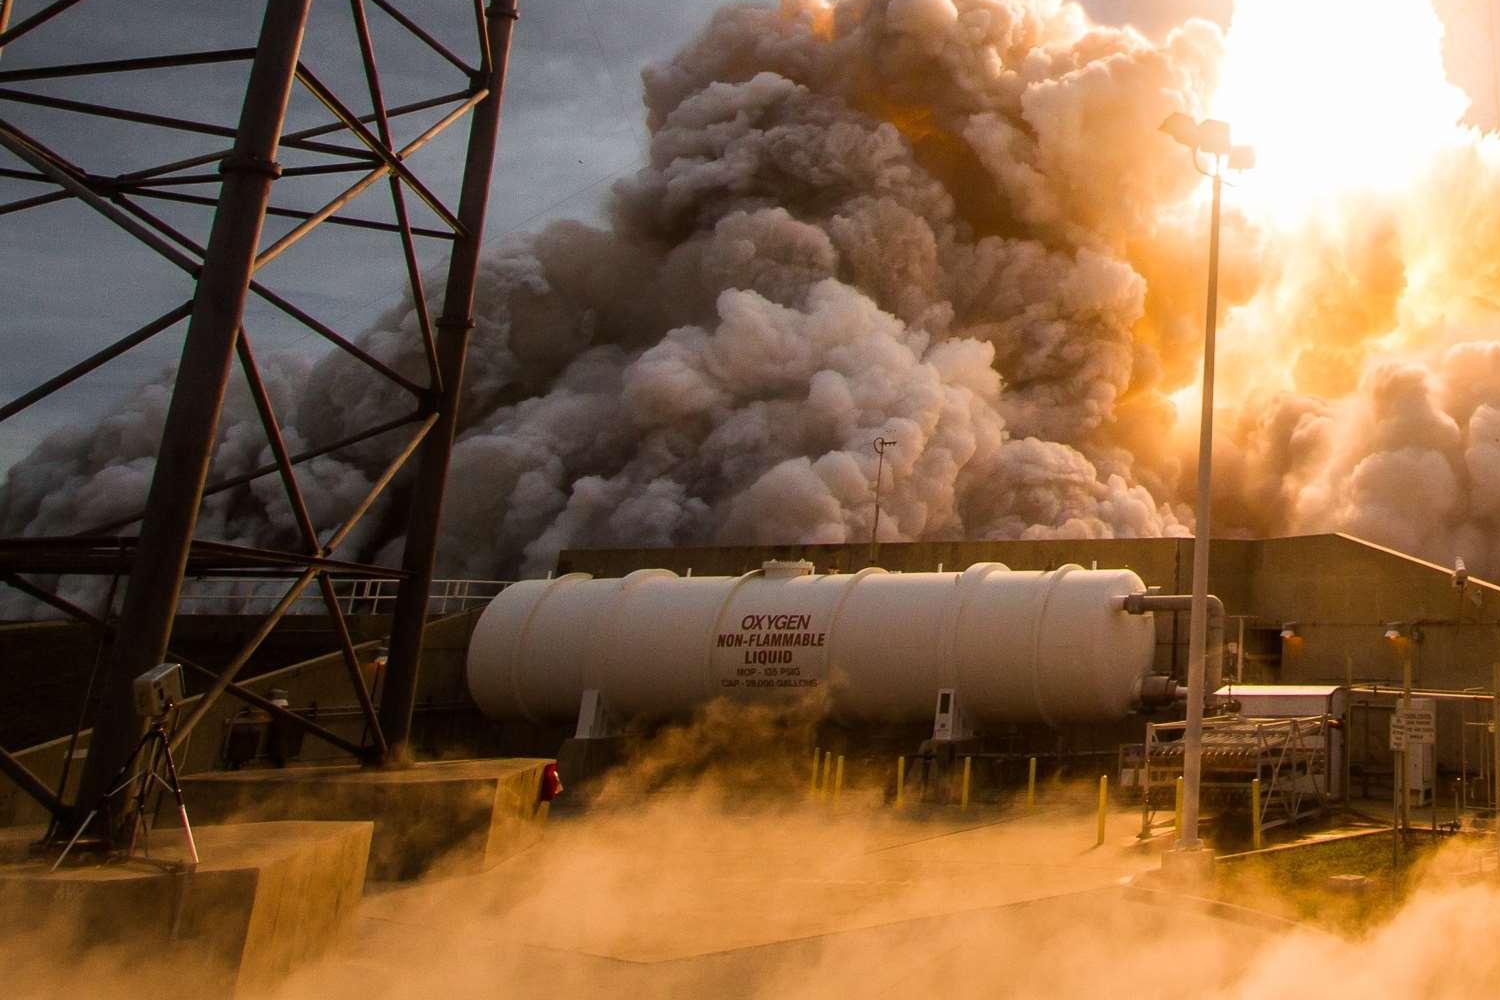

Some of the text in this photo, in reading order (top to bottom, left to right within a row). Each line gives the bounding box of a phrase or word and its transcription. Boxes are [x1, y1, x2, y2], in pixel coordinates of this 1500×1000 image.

[741, 614, 811, 630] OXYGEN
[716, 632, 825, 648] NON-FLAMMABLE
[744, 650, 792, 665] LIQUID
[776, 679, 818, 688] GALLONS
